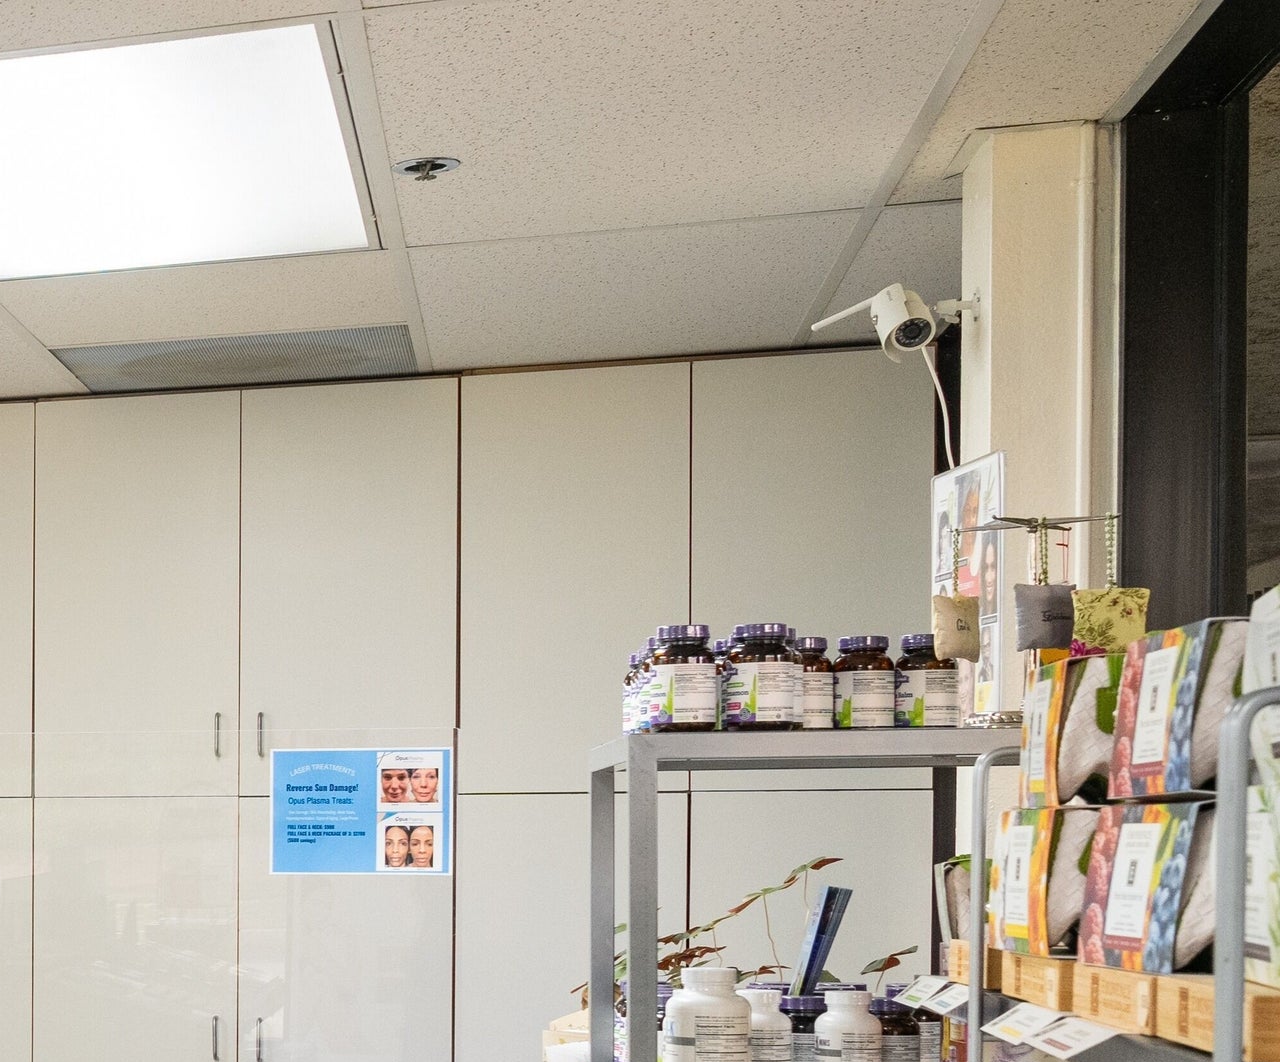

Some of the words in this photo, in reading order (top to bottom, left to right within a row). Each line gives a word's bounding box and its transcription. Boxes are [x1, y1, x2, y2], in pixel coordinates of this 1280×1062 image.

[289, 765, 311, 777] LASER
[311, 763, 355, 776] TREATMENTS
[286, 784, 313, 792] Reverse
[315, 784, 327, 792] Sun
[330, 784, 359, 794] Damage!
[288, 797, 305, 805] Opus
[307, 797, 330, 805] Plasma
[332, 797, 354, 805] Treats:
